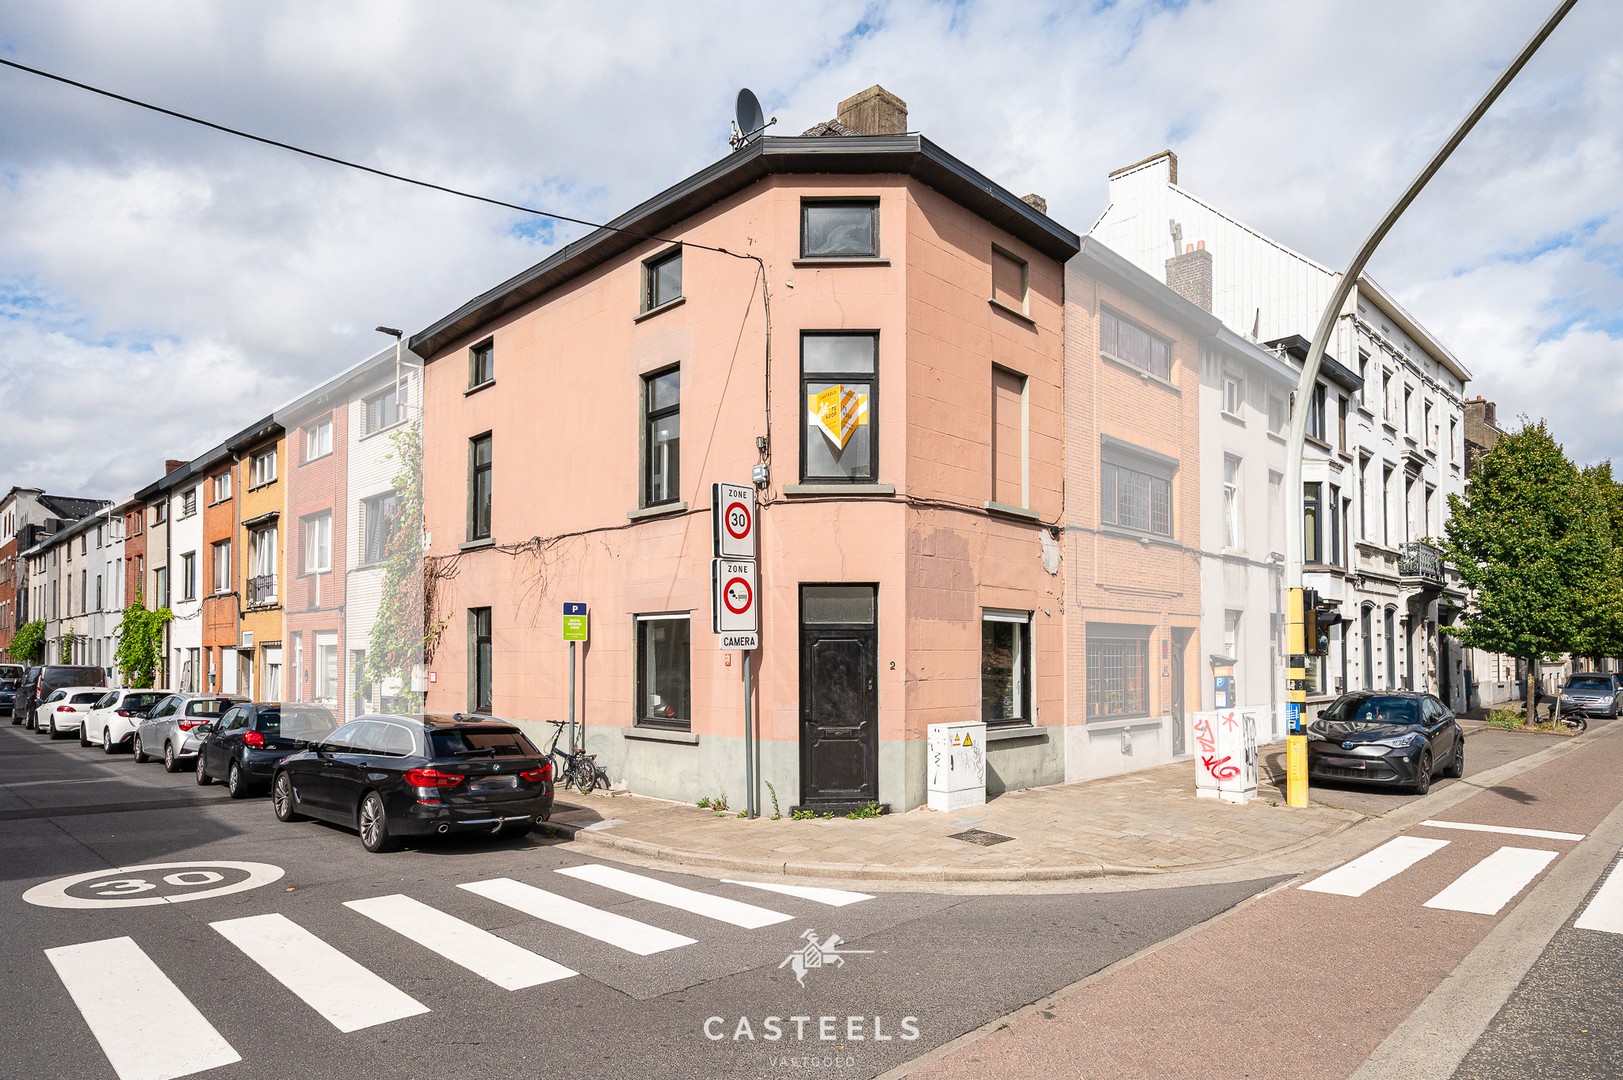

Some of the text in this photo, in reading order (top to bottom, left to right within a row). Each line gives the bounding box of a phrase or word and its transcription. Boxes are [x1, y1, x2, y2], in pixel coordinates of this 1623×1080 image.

[728, 489, 747, 499] ZONE
[731, 513, 746, 527] 30
[727, 565, 748, 573] ZONE
[723, 636, 756, 647] CAMERA
[890, 661, 896, 670] 2
[90, 871, 224, 896] 30
